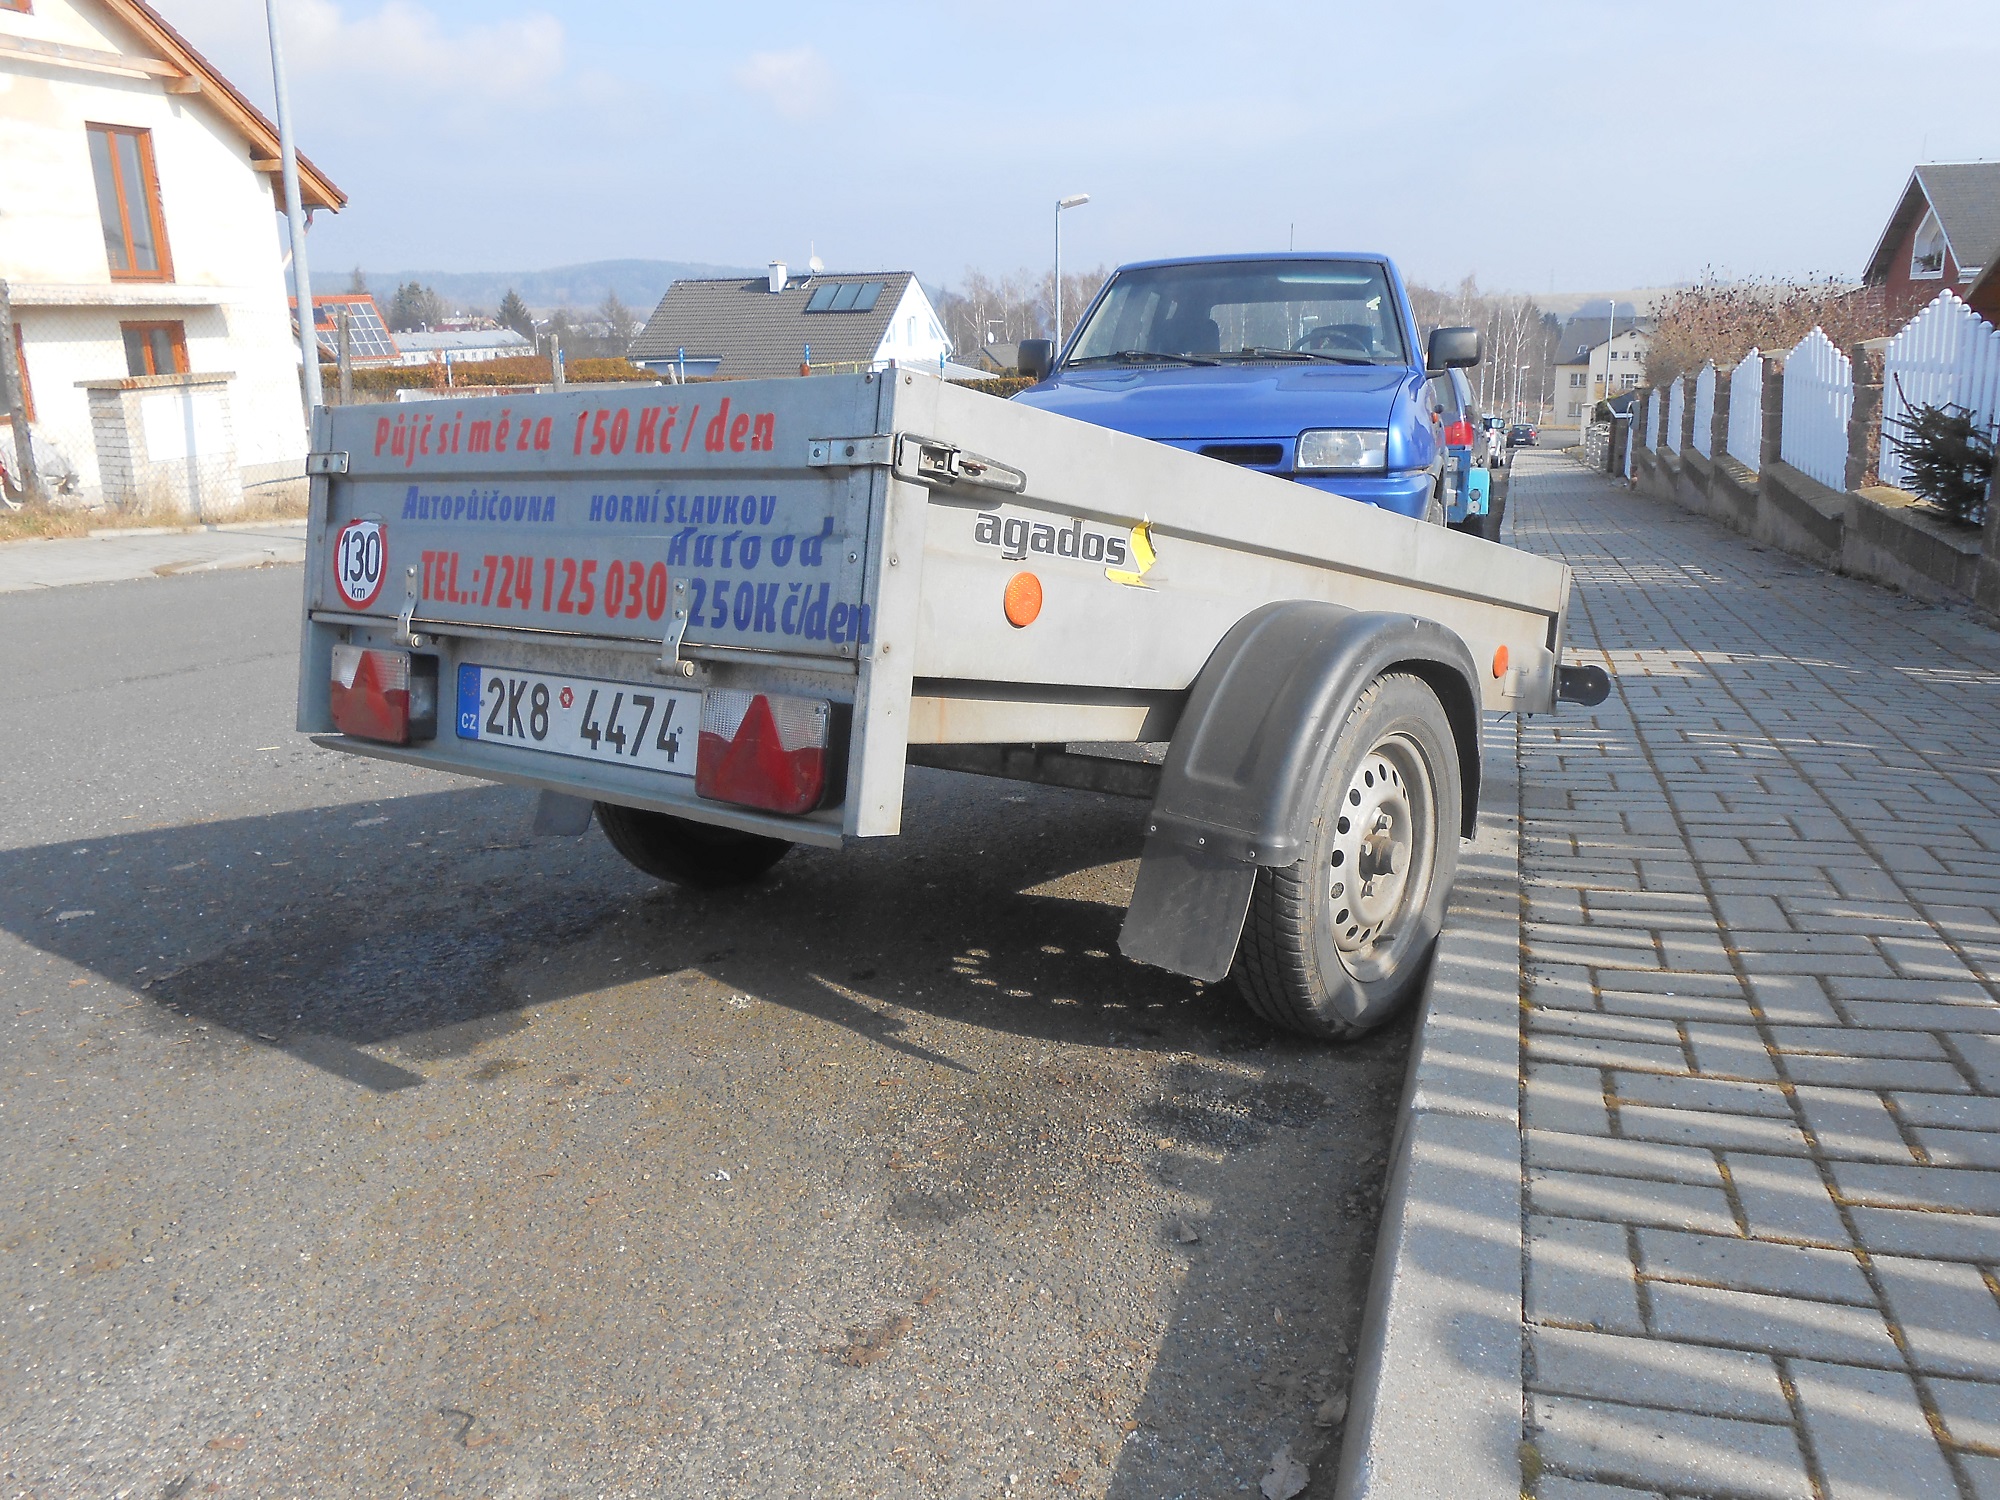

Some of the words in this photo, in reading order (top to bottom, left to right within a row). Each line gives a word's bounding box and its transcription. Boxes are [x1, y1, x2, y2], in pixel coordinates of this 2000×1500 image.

[374, 413, 433, 468] Půjč
[437, 411, 463, 454] si
[467, 409, 512, 453] mě
[516, 416, 553, 452] za
[573, 408, 629, 456] 150
[635, 406, 679, 455] Kč
[704, 397, 775, 452] den
[588, 489, 661, 524] HORNÍ
[663, 496, 777, 526] SLAVKOV
[342, 531, 380, 582] 130
[666, 527, 763, 570] Auto
[771, 516, 835, 568] od
[974, 512, 1127, 566] agados
[351, 583, 365, 598] km
[542, 557, 598, 616] 125
[603, 559, 668, 622] 030
[461, 712, 477, 730] CZ
[485, 677, 551, 741] 2K8
[580, 689, 679, 763] 4474
